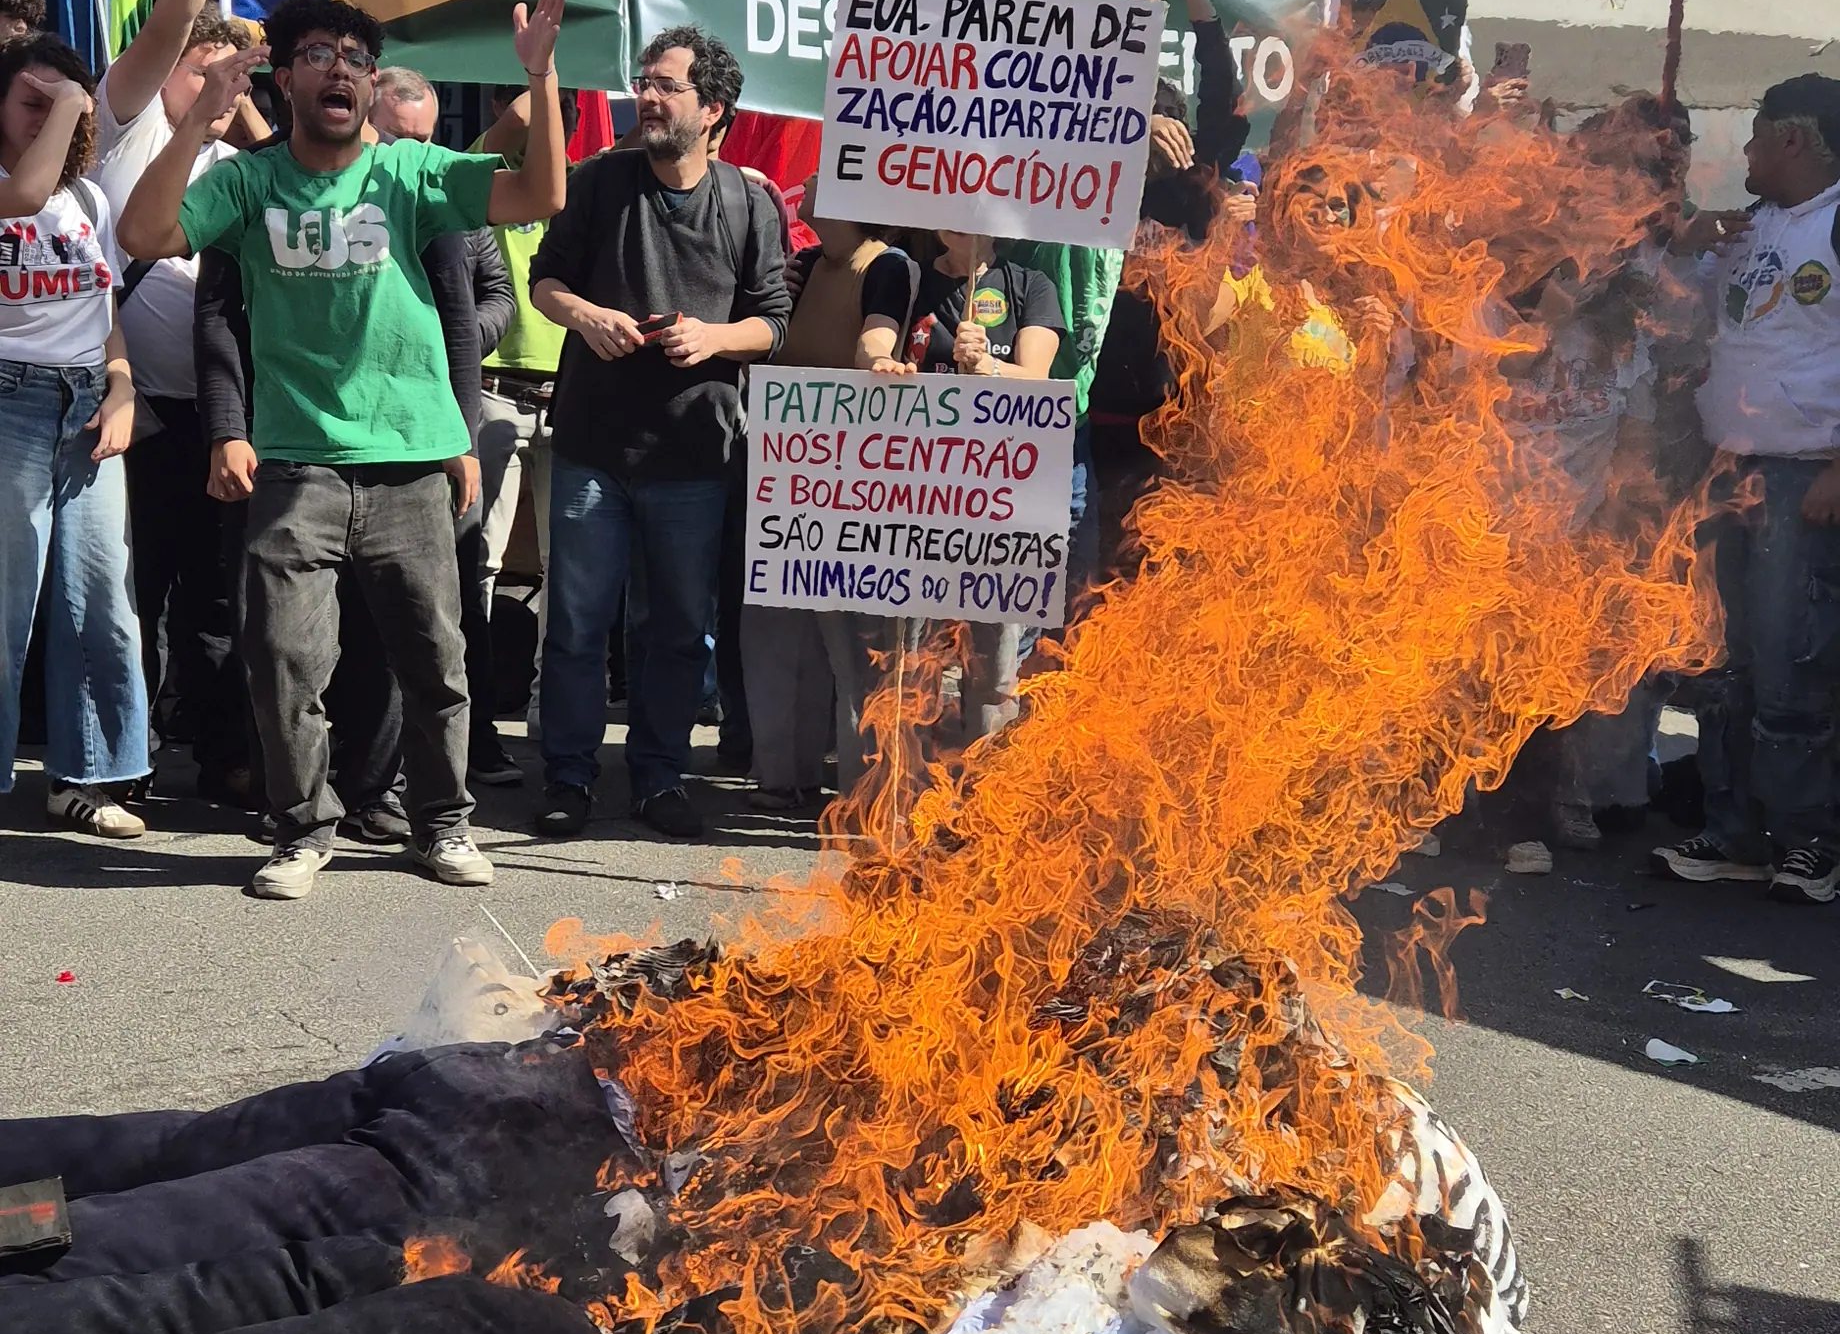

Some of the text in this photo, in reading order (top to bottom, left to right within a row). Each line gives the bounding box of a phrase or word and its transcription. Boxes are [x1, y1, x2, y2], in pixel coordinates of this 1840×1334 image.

[1090, 3, 1153, 54] DE
[834, 33, 1135, 101] APOIAR COLONI-
[960, 96, 1147, 145] APARTHEID
[836, 144, 867, 181] E
[877, 143, 1123, 225] GENOCÍDIO!
[0, 262, 113, 301] UMES
[764, 380, 1072, 430] PATRIOTAS SOMOS
[763, 428, 1039, 481] NÓS! CENTRÃO
[756, 473, 1014, 522] E BOLSOMINIOS
[758, 512, 1065, 569] SÃO ENTREGUISTAS
[749, 558, 1057, 619] E INIMIGOS DO POVO!
